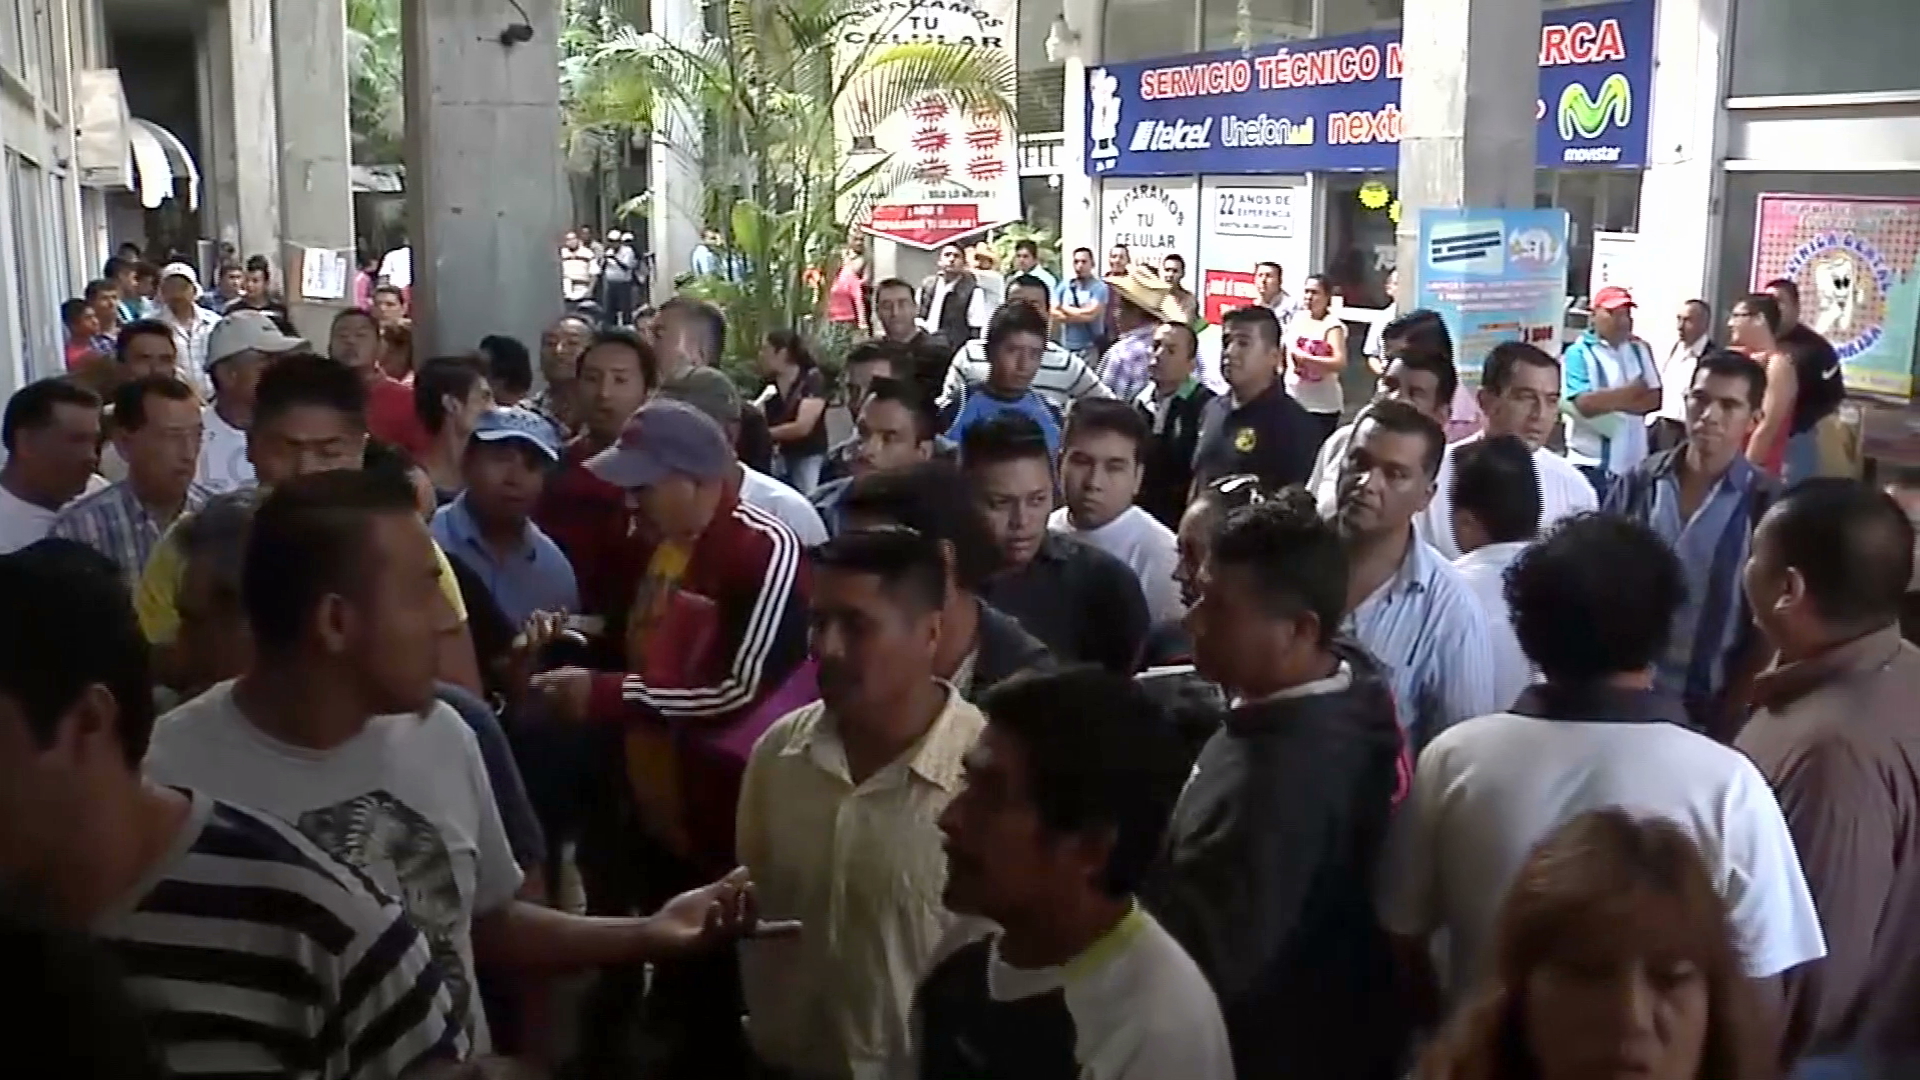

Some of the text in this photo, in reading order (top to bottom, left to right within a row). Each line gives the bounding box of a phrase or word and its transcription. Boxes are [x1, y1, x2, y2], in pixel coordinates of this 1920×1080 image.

[908, 16, 939, 30] TU
[1140, 60, 1251, 100] SERVICIO
[1255, 47, 1380, 89] TÉCNICO
[1539, 19, 1626, 66] RCA
[1328, 104, 1403, 145] next
[1219, 193, 1235, 215] 22
[1275, 195, 1291, 205] DE
[1137, 213, 1154, 227] TU
[1116, 233, 1176, 249] CELULAR
